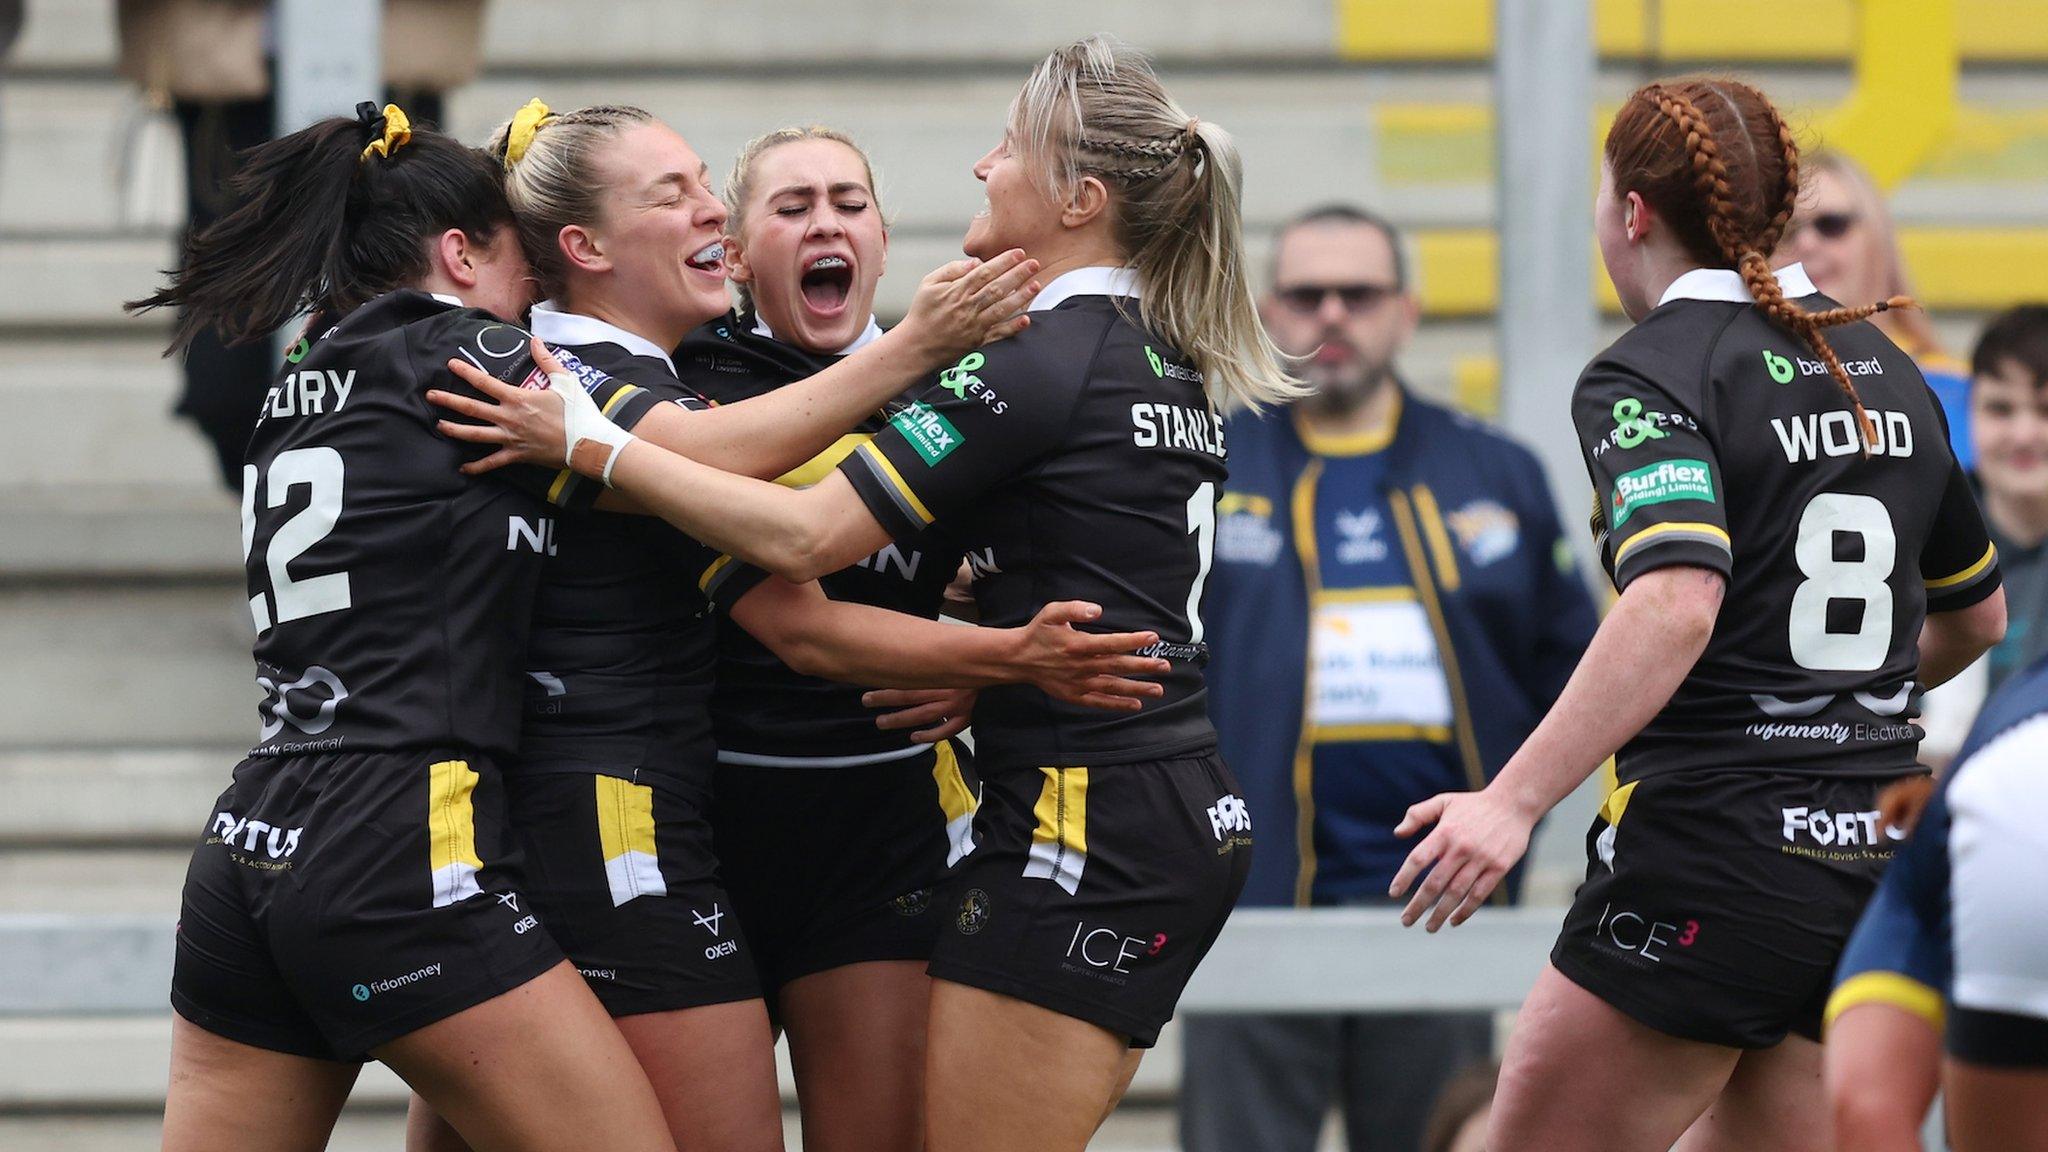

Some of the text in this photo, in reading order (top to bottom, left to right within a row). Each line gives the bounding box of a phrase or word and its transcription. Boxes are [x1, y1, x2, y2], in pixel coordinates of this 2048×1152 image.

[1796, 357, 1884, 377] barrcard
[911, 426, 941, 458] Limited
[1131, 403, 1228, 460] STANLE
[1770, 409, 1914, 464] WOOD
[1617, 463, 1708, 501] Burflex
[1668, 482, 1710, 497] Limited
[1789, 492, 1897, 672] 8
[1855, 723, 1915, 741] Electrical
[1781, 845, 1827, 859] BUSINESS
[704, 939, 738, 960] OXEN
[370, 962, 441, 995] fidomoney
[576, 968, 617, 981] oney
